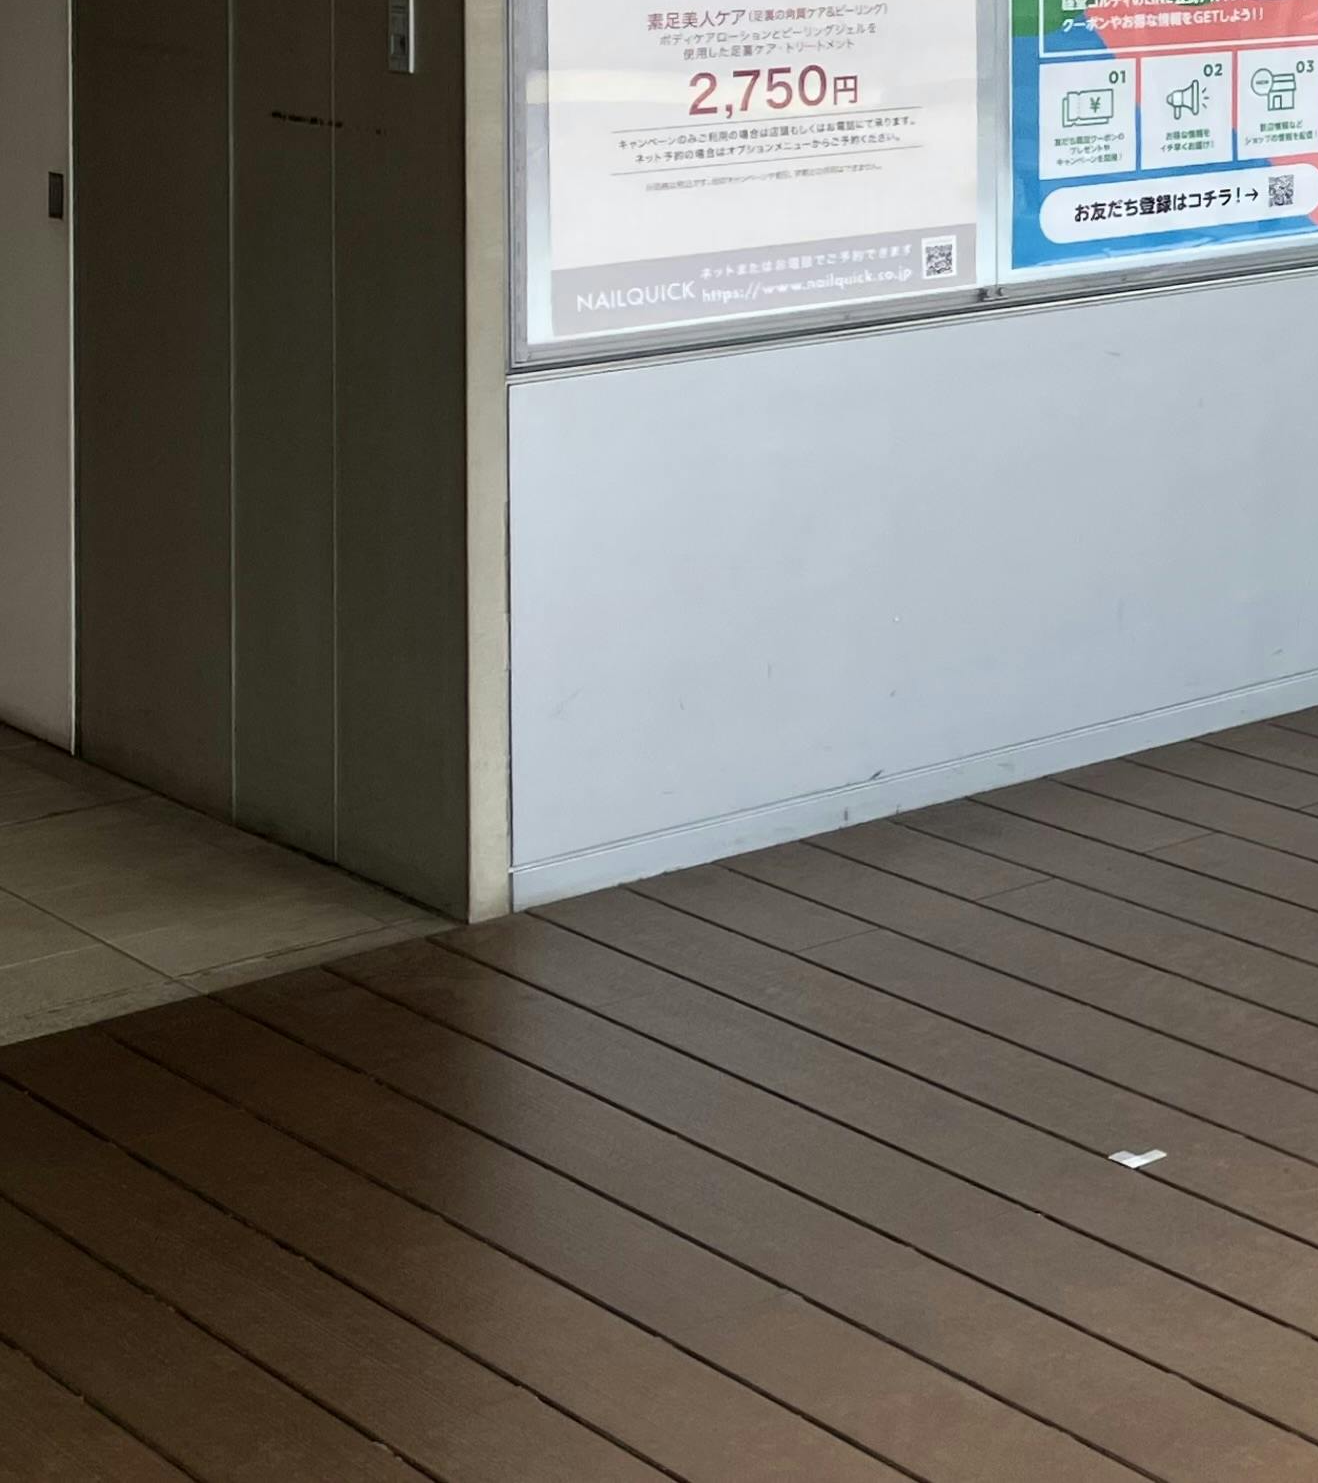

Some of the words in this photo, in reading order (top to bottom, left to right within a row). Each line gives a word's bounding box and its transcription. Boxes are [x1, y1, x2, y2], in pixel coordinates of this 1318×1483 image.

[647, 9, 746, 31] 素足美人ケア
[1108, 70, 1127, 84] 01
[1203, 63, 1223, 78] 02
[1296, 60, 1314, 74] 03
[688, 64, 859, 119] 2,750円
[702, 267, 912, 303] https://www.nailquick.co.jp
[577, 280, 696, 313] NAILQUICK
